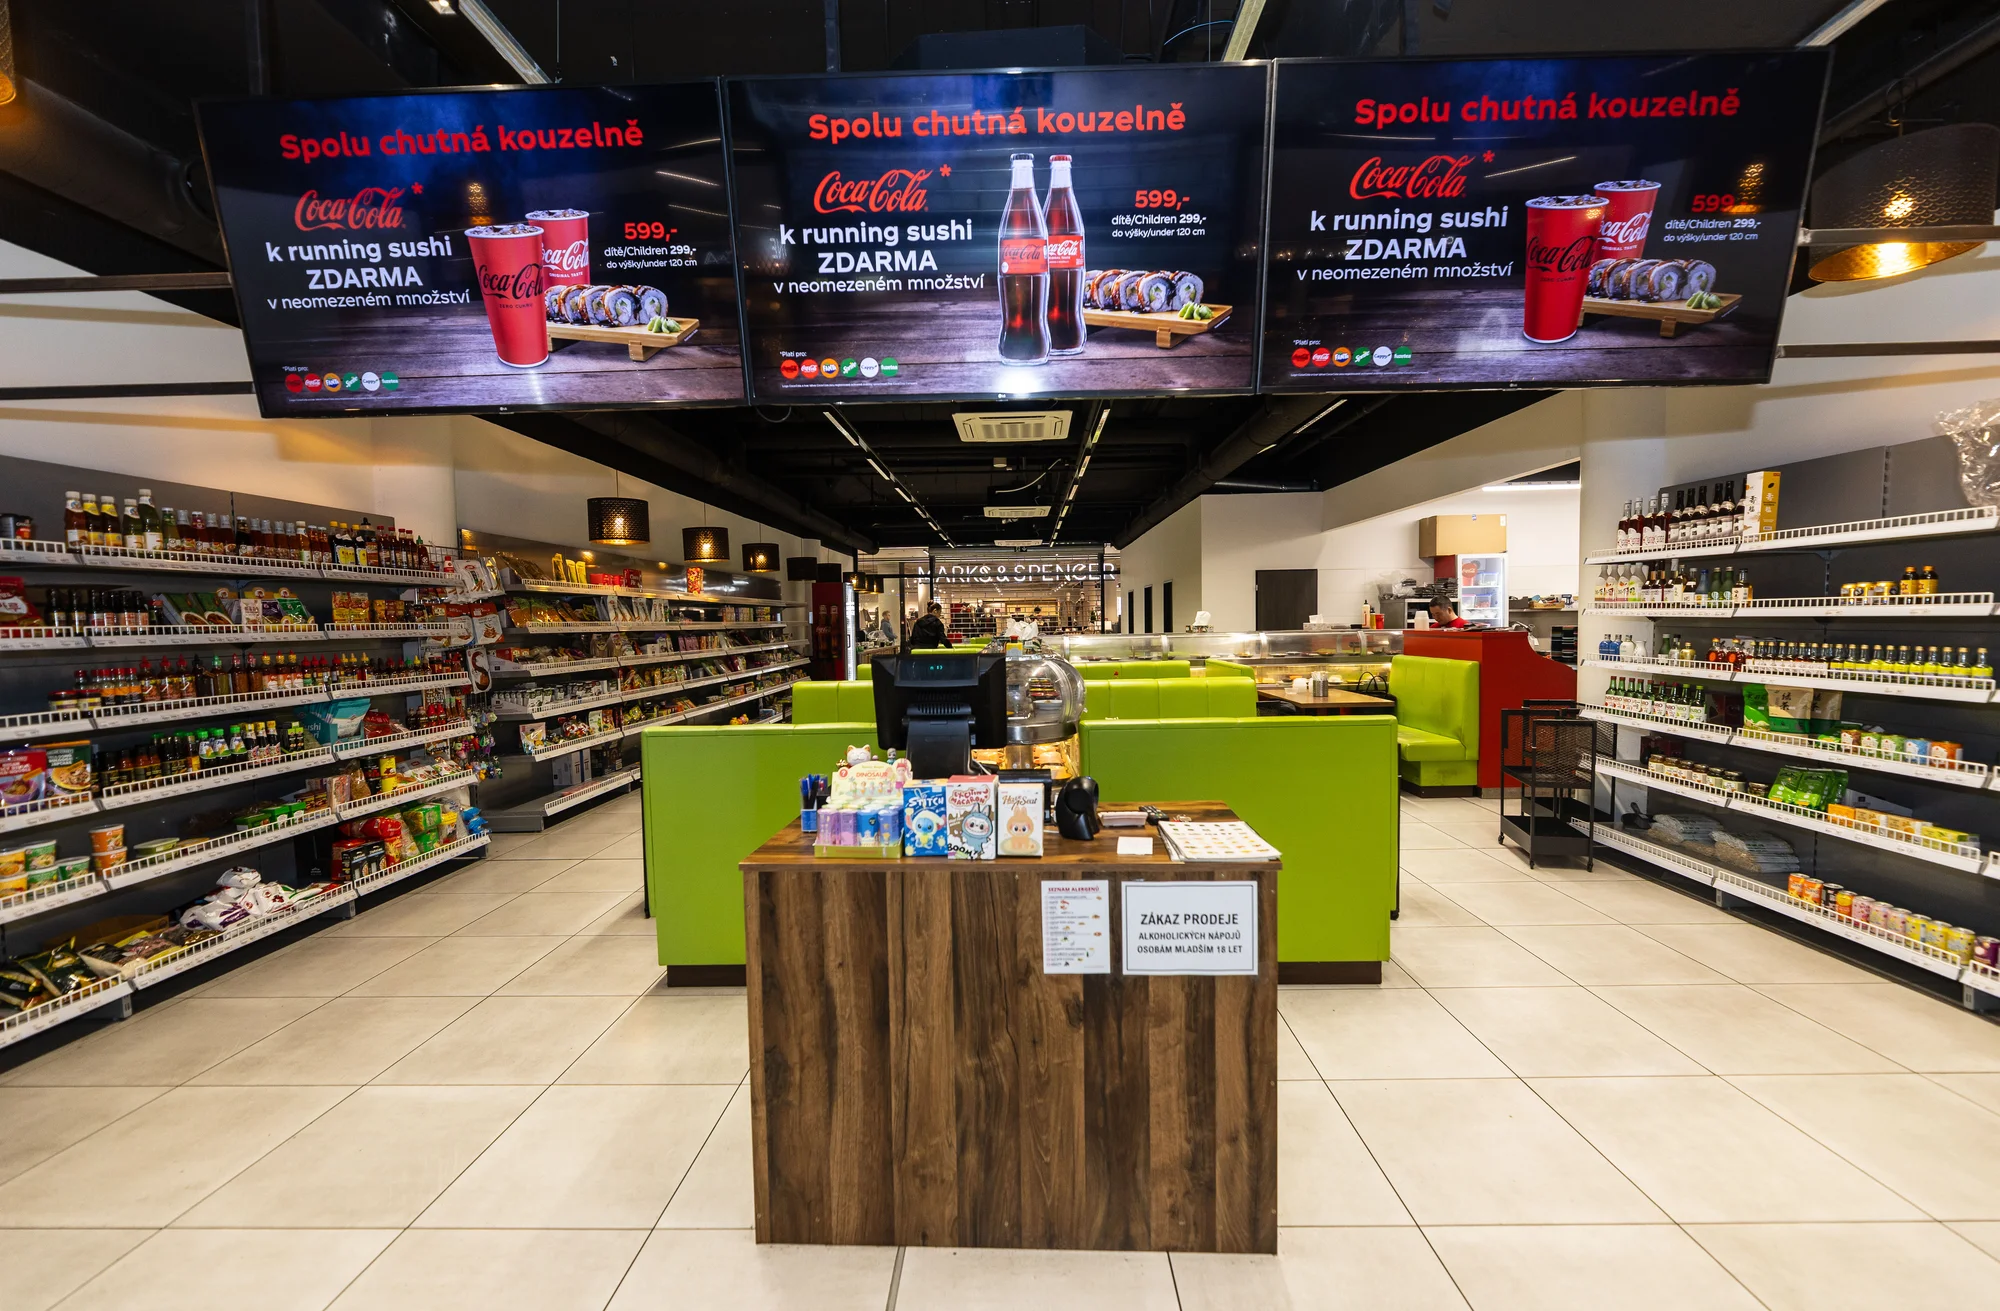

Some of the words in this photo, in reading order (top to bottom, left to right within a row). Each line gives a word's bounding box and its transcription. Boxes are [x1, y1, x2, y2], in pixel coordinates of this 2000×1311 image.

[1354, 97, 1451, 130] Spolu
[1460, 92, 1577, 122] chutná
[1588, 87, 1740, 120] kouzelně
[808, 111, 902, 145] Spolu
[912, 106, 1028, 136] chutná
[1037, 101, 1186, 133] kouzelně
[280, 131, 370, 165] Spolu
[379, 124, 491, 157] chutná
[500, 119, 644, 153] kouzelně
[1349, 154, 1476, 200] Coca-Cola
[813, 169, 933, 214] Coca-Cola
[1135, 189, 1191, 211] 599,-
[294, 187, 406, 232] Coca-Cola
[1111, 214, 1177, 226] dítě/Children
[1179, 213, 1207, 225] 299,-
[1309, 211, 1327, 232] k
[1333, 209, 1432, 236] running
[1440, 205, 1509, 228] sushi
[624, 221, 678, 243] 599,-
[780, 224, 797, 244] k
[802, 222, 900, 250] running
[907, 219, 973, 241] sushi
[1112, 229, 1124, 237] do
[1124, 228, 1175, 239] výšky/under
[1176, 227, 1191, 236] 120
[1192, 228, 1205, 236] cm
[1665, 219, 1731, 230] dítě/Children
[1733, 218, 1762, 229] 299,-
[1677, 233, 1727, 243] výšky/under
[1729, 232, 1743, 240] 120
[266, 242, 283, 263] k
[288, 240, 381, 268] running
[387, 236, 452, 258] sushi
[604, 246, 668, 257] dítě/Children
[670, 245, 697, 255] 299,-
[1003, 243, 1041, 260] Coca-Cola
[1345, 237, 1468, 261] ZDARMA
[1527, 236, 1597, 273] Coca-Cola
[618, 259, 667, 270] výšky/under
[818, 250, 939, 275] ZDARMA
[1296, 269, 1308, 281] v
[1310, 263, 1429, 280] neomezeném
[1434, 260, 1512, 278] množství
[308, 266, 424, 290] ZDARMA
[478, 263, 544, 300] Coca-Cola
[773, 281, 785, 293] v
[788, 276, 902, 293] neomezeném
[907, 273, 985, 291] množství
[266, 299, 278, 310] v
[281, 291, 391, 310] neomezeném
[396, 288, 470, 307] množství
[909, 796, 944, 807] STITCH
[1140, 911, 1180, 925] ZÁKAZ
[1184, 913, 1239, 925] PRODEJE
[1139, 930, 1206, 940] ALKOHOLICKÝCH
[1208, 930, 1241, 940] NÁPOJŮ
[1137, 944, 1172, 953] OSOBÁM
[1175, 944, 1214, 953] MLADŠÍM
[1229, 945, 1242, 953] LET
